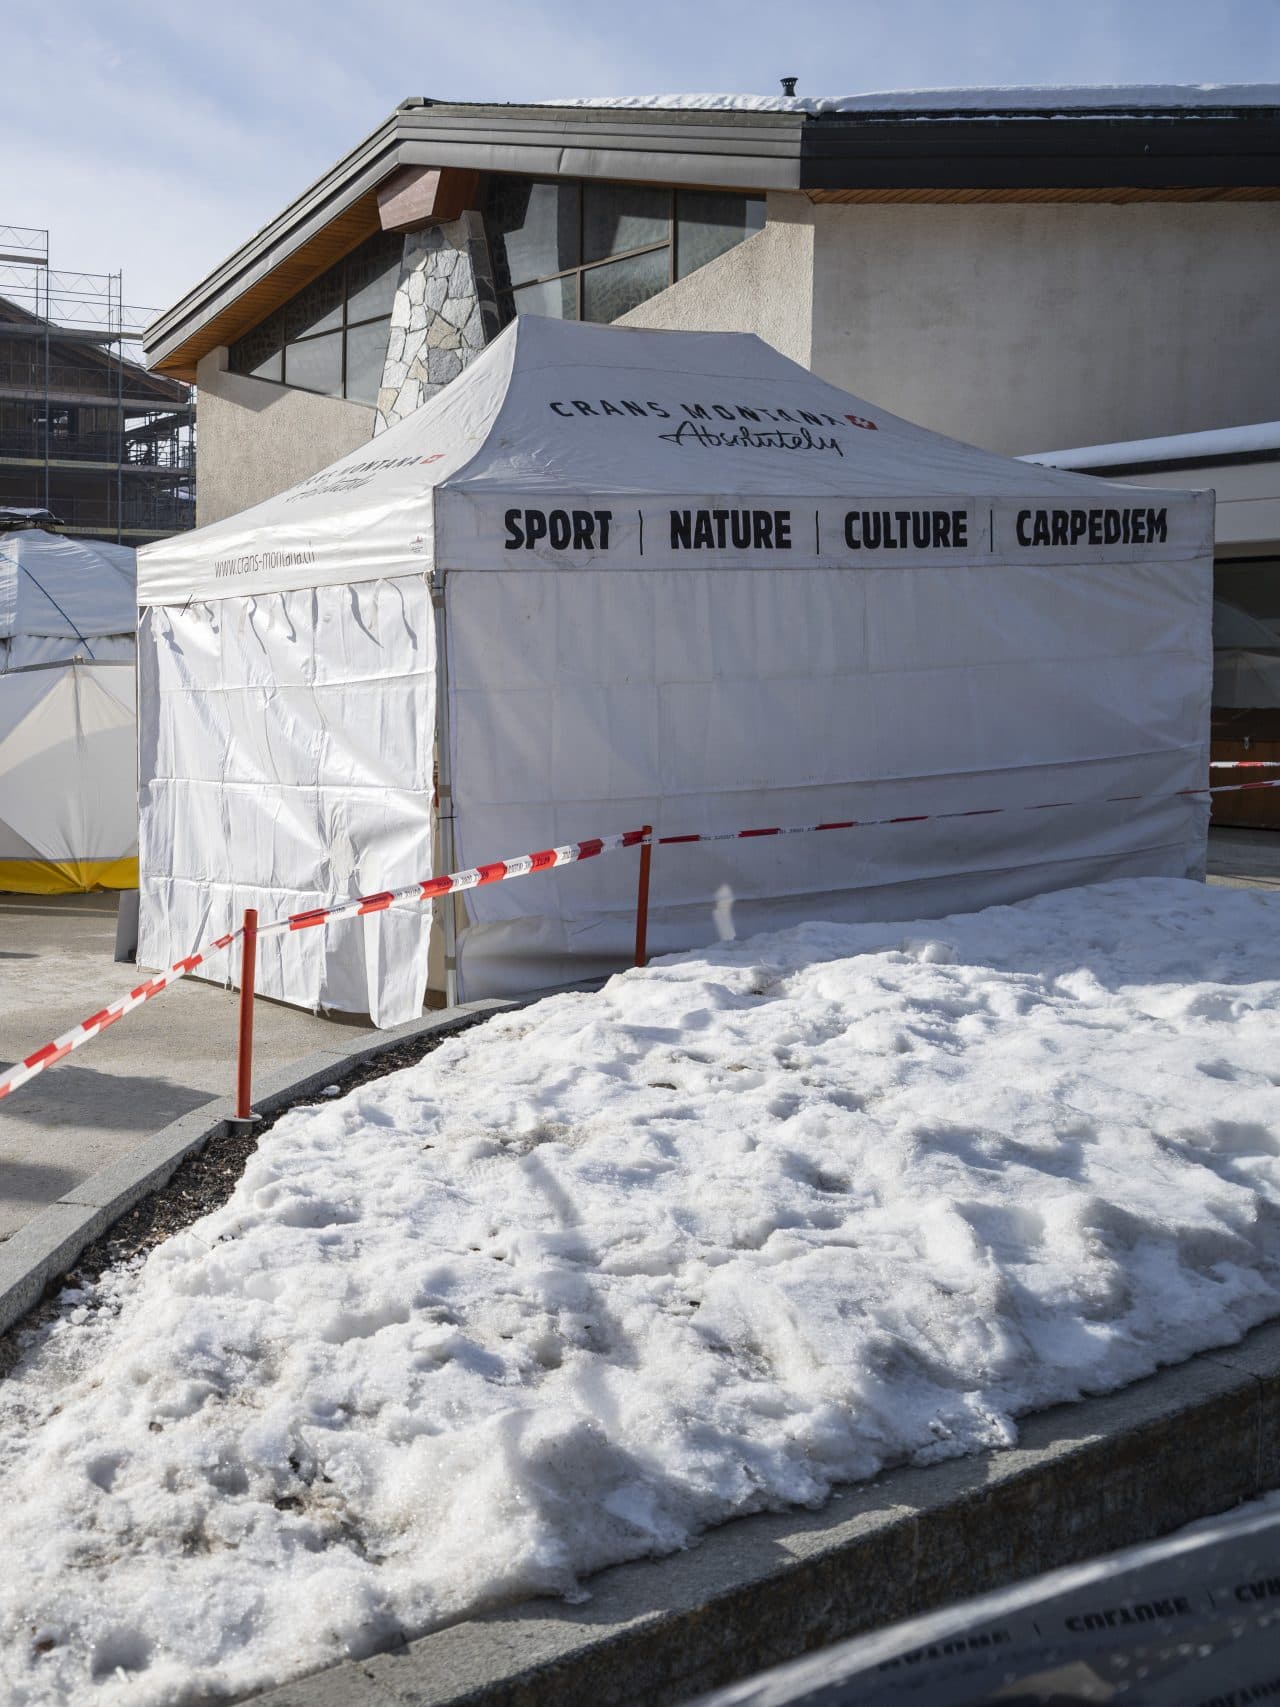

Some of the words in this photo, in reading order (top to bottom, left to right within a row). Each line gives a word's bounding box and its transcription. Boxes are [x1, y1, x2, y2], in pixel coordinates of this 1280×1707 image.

[549, 400, 671, 418] CRANS
[680, 403, 847, 427] MONTANA
[658, 420, 845, 458] Absolutely
[505, 508, 612, 550] SPORT
[670, 510, 792, 549] NATURE
[845, 510, 968, 549] CULTURE
[1016, 508, 1168, 546] CARPEDIEM
